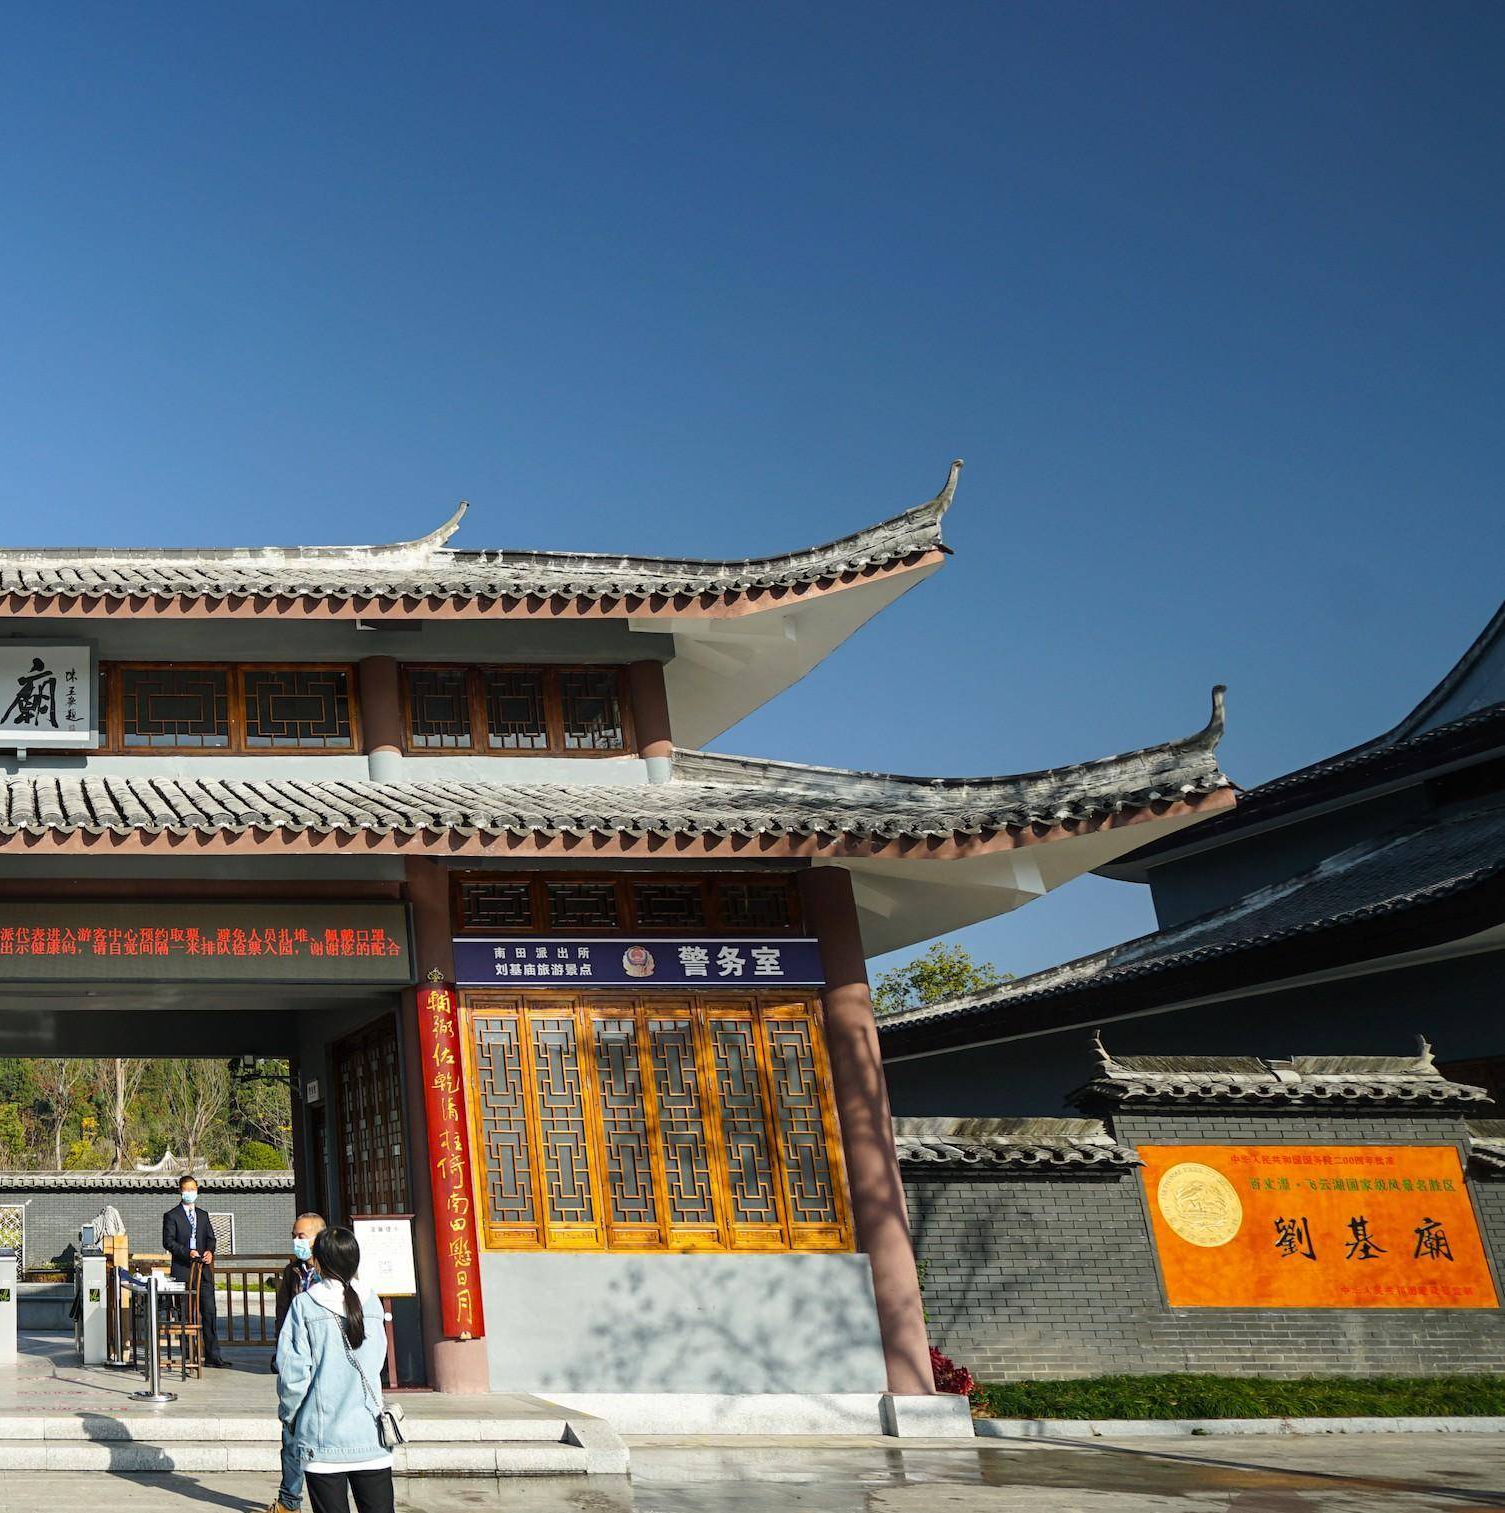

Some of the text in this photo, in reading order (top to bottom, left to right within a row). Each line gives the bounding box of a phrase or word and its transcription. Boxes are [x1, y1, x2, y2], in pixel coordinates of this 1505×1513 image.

[494, 947, 591, 960] 南田派出所
[678, 946, 785, 978] 警务室
[495, 963, 593, 976] 刘基庙旅游景点
